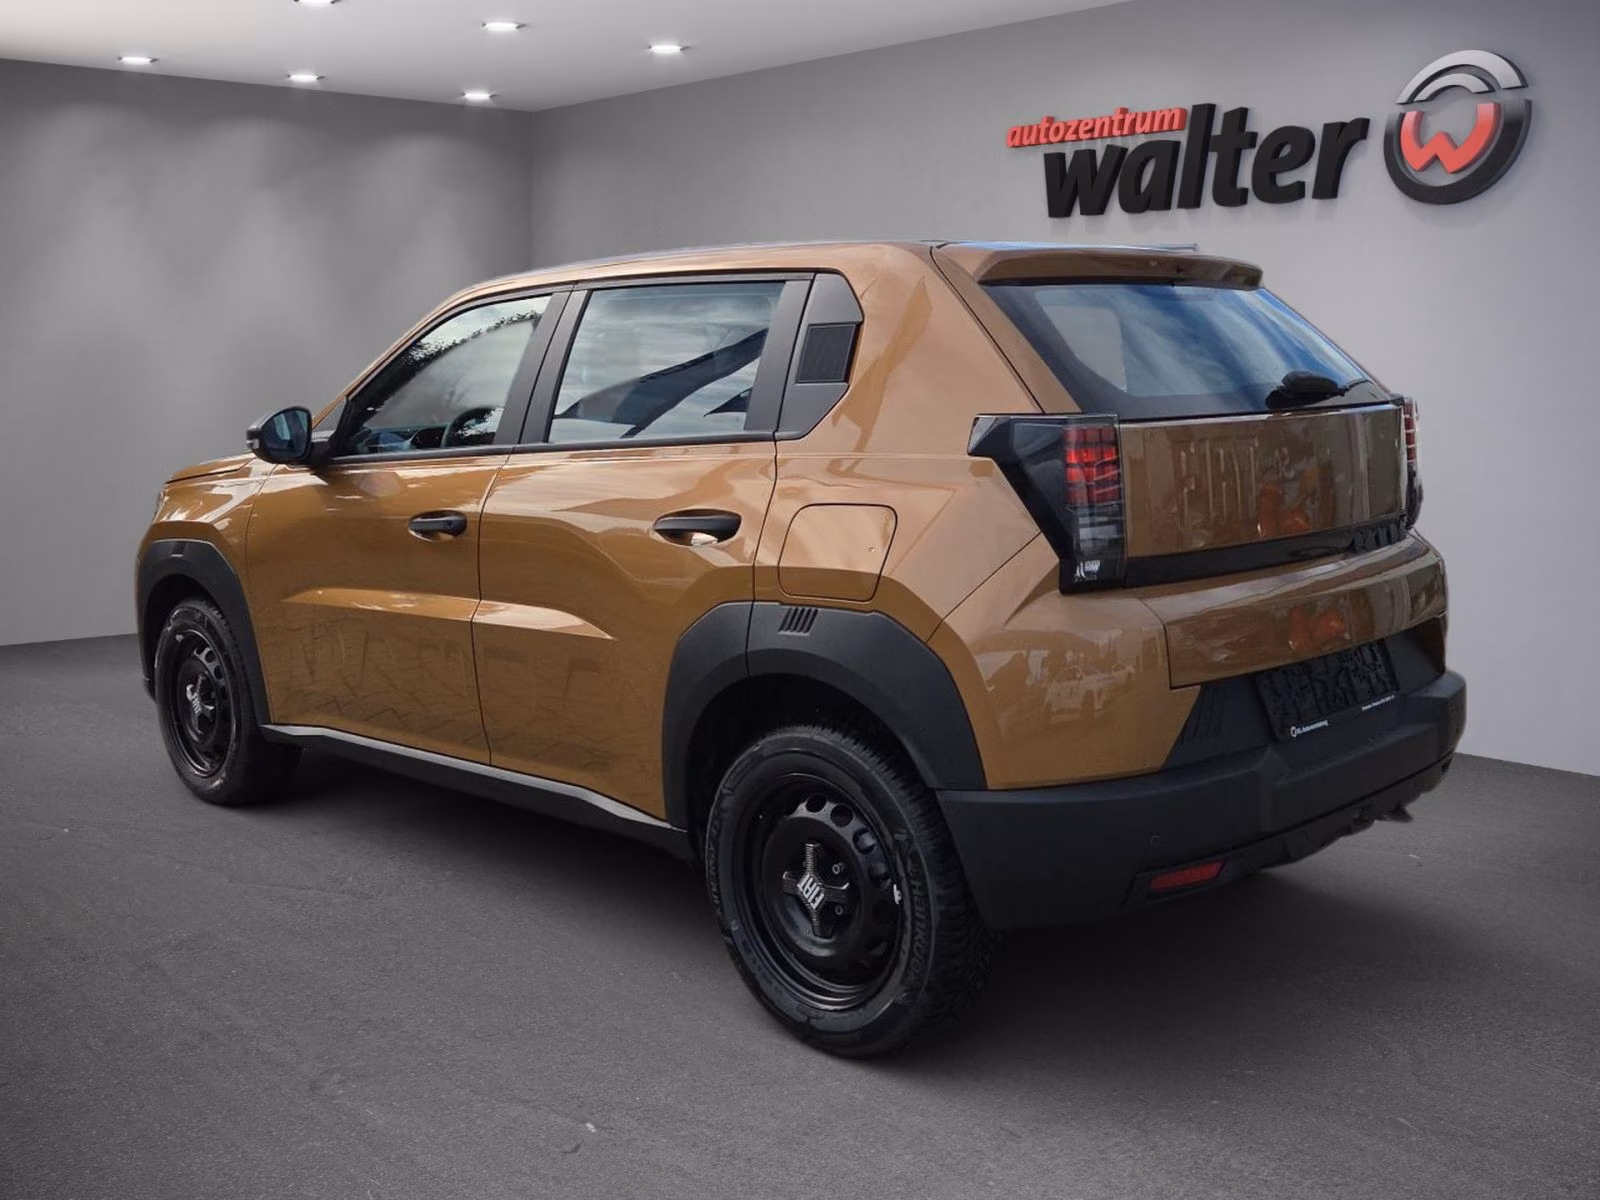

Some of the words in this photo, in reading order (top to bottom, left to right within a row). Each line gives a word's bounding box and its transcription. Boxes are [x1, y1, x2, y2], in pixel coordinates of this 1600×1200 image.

[1005, 105, 1188, 149] autozentrum
[1043, 102, 1369, 218] walter
[796, 872, 826, 911] FIAT
